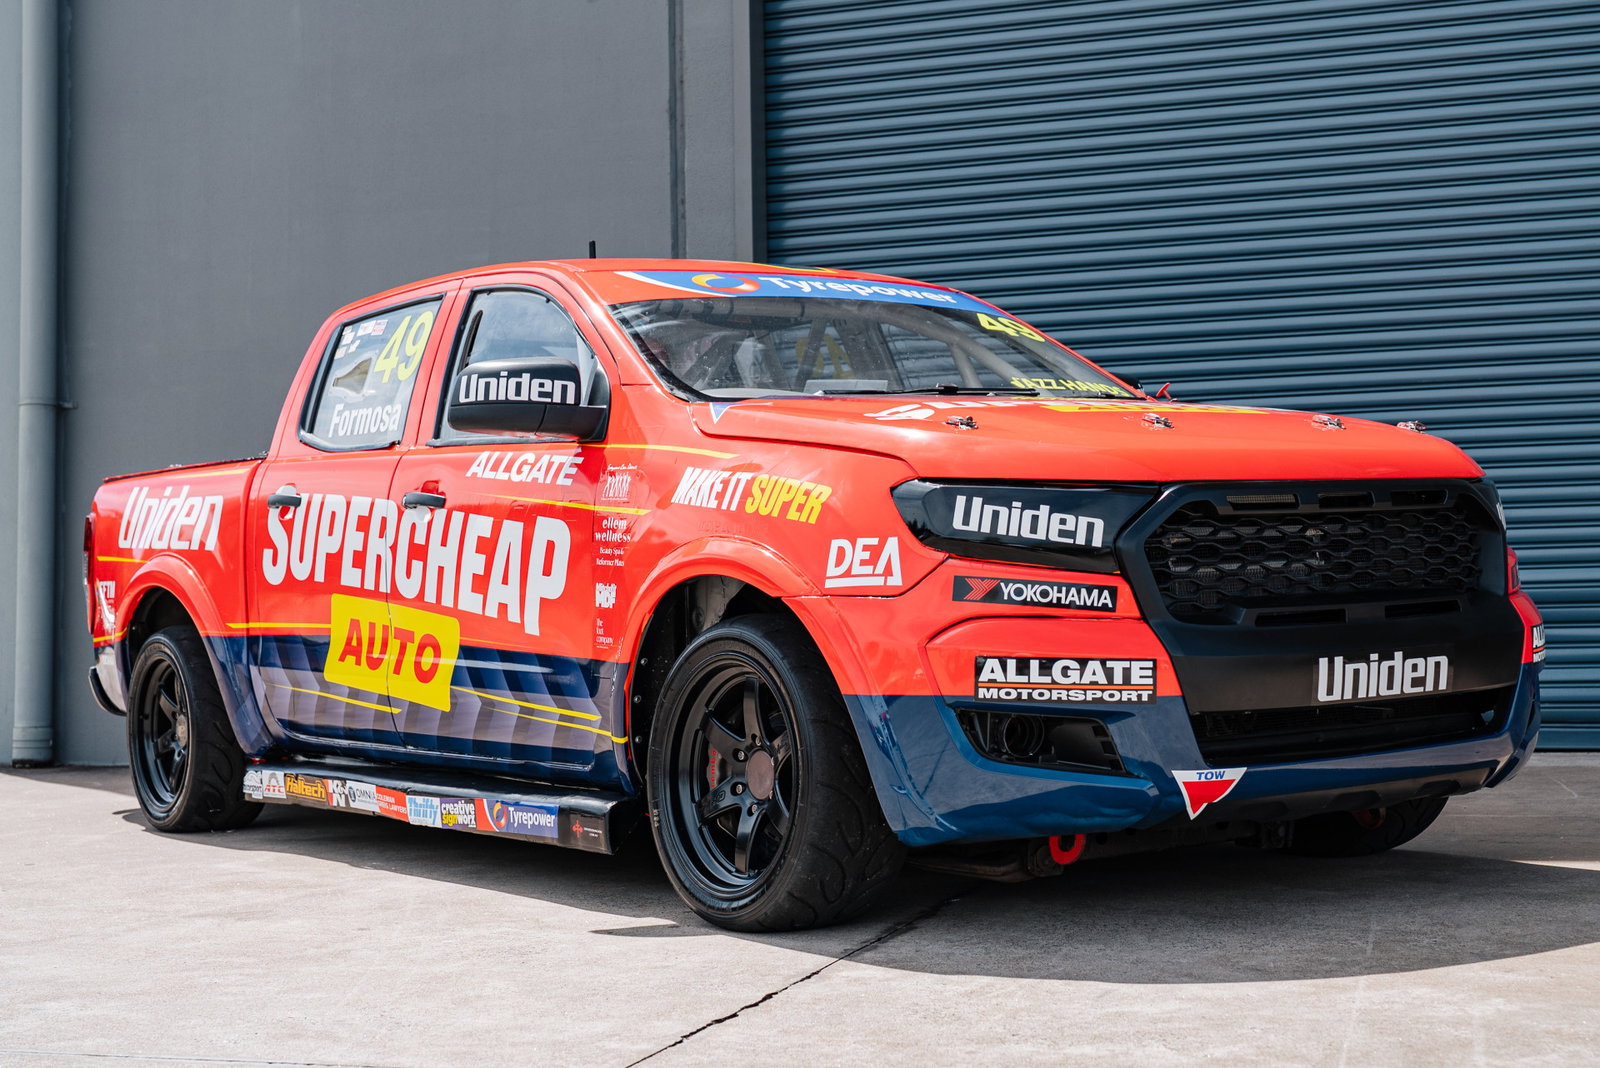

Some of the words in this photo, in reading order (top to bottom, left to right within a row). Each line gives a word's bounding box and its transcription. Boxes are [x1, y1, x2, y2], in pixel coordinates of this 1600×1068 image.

[758, 276, 957, 304] Tyrepower
[977, 312, 1046, 343] 49
[373, 310, 435, 385] 49
[459, 371, 576, 405] Uniden
[1011, 376, 1066, 391] JAZZ
[328, 402, 403, 439] Formosa
[466, 451, 584, 487] ALLGATE
[671, 466, 728, 508] MAKE
[721, 471, 755, 511] IT
[745, 473, 833, 525] SUPER
[118, 485, 224, 551] Uniden
[602, 516, 627, 530] ellem
[952, 495, 1105, 548] Uniden
[595, 530, 631, 543] wellness
[262, 492, 571, 636] SUPERCHEAP
[825, 536, 903, 588] DEA
[1000, 581, 1113, 608] YOKOHAMA
[338, 617, 442, 684] AUTO
[978, 658, 1154, 685] ALLGATE
[1317, 651, 1449, 702] Uniden
[978, 687, 1153, 702] MOTORSPORT
[286, 774, 326, 800] Haltech
[1196, 770, 1226, 781] TOW
[407, 795, 439, 825] Thrifty
[441, 799, 475, 815] creative
[508, 806, 556, 828] Tyrepower
